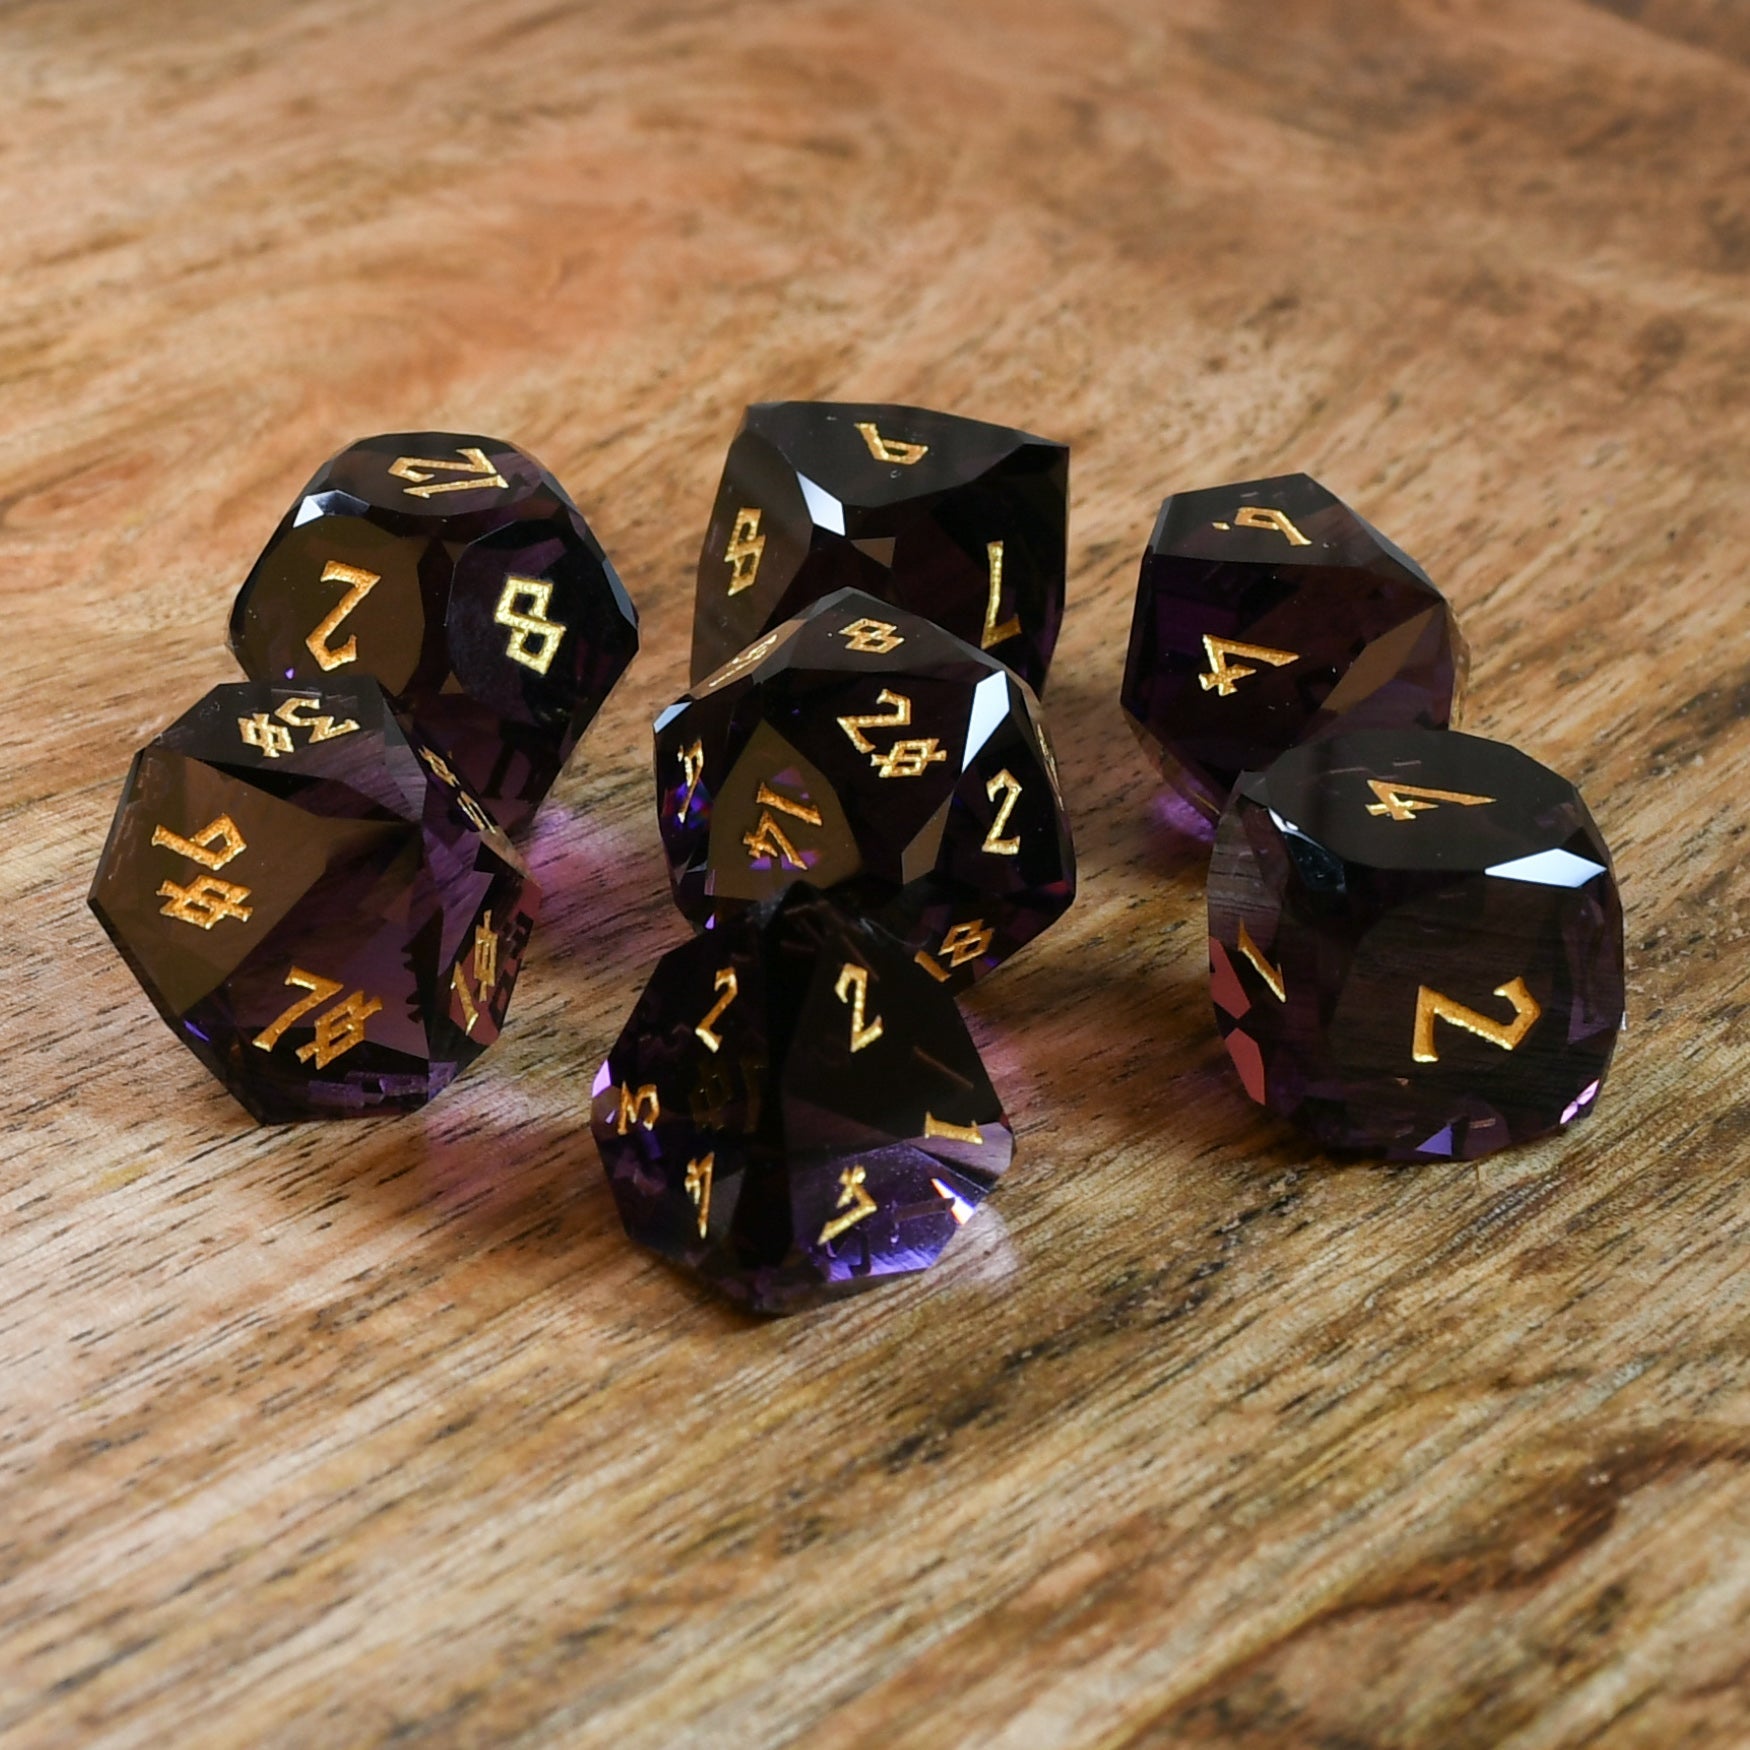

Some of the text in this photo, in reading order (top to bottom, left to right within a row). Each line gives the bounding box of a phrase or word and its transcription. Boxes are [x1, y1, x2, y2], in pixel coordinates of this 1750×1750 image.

[387, 447, 510, 498] 12
[724, 508, 766, 596] 8
[305, 560, 381, 672] 2
[494, 575, 567, 675] 8
[839, 618, 904, 654] 8
[1198, 634, 1299, 697] 4
[237, 697, 360, 758] 30
[836, 688, 947, 778] 20
[743, 784, 822, 870] 14
[981, 766, 1022, 856] 2
[1365, 779, 1495, 821] 4
[450, 910, 498, 1035] 10
[914, 919, 991, 983] 18
[1238, 918, 1286, 1005] 1
[252, 968, 383, 1070] 70
[695, 968, 738, 1053] 2
[835, 963, 883, 1053] 2
[1412, 977, 1540, 1063] 2
[616, 1079, 660, 1136] 3
[924, 1113, 985, 1146] 1
